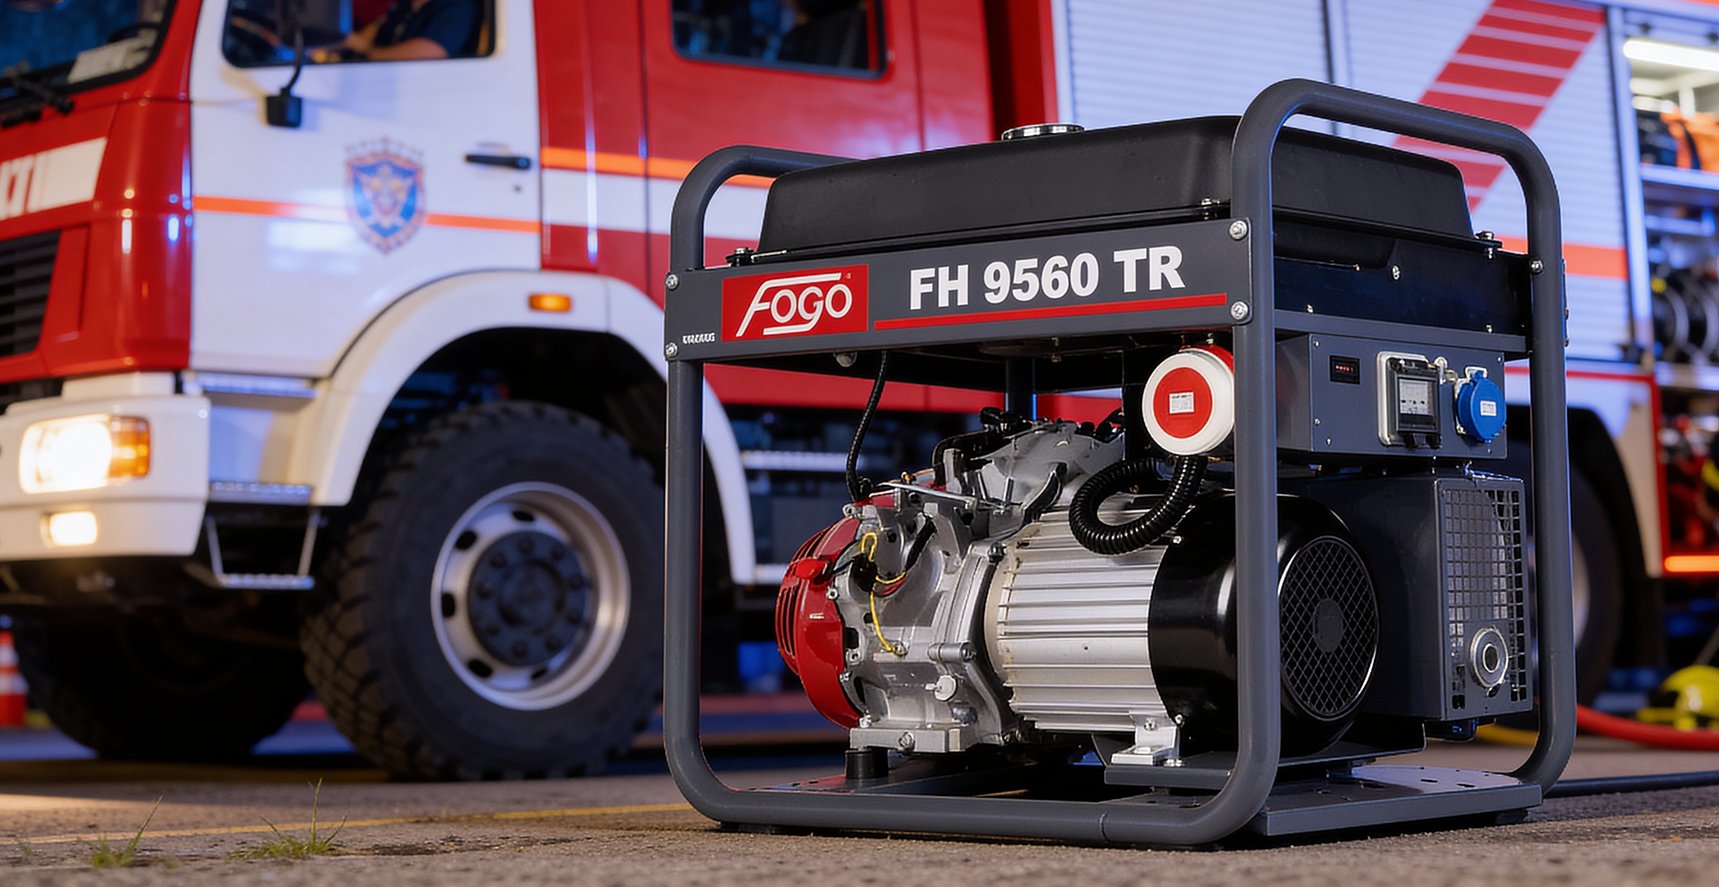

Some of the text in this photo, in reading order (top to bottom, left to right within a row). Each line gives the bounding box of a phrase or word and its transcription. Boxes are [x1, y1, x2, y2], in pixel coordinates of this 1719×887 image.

[735, 272, 853, 337] FOGO
[909, 245, 1187, 311] FH 9560 TR
